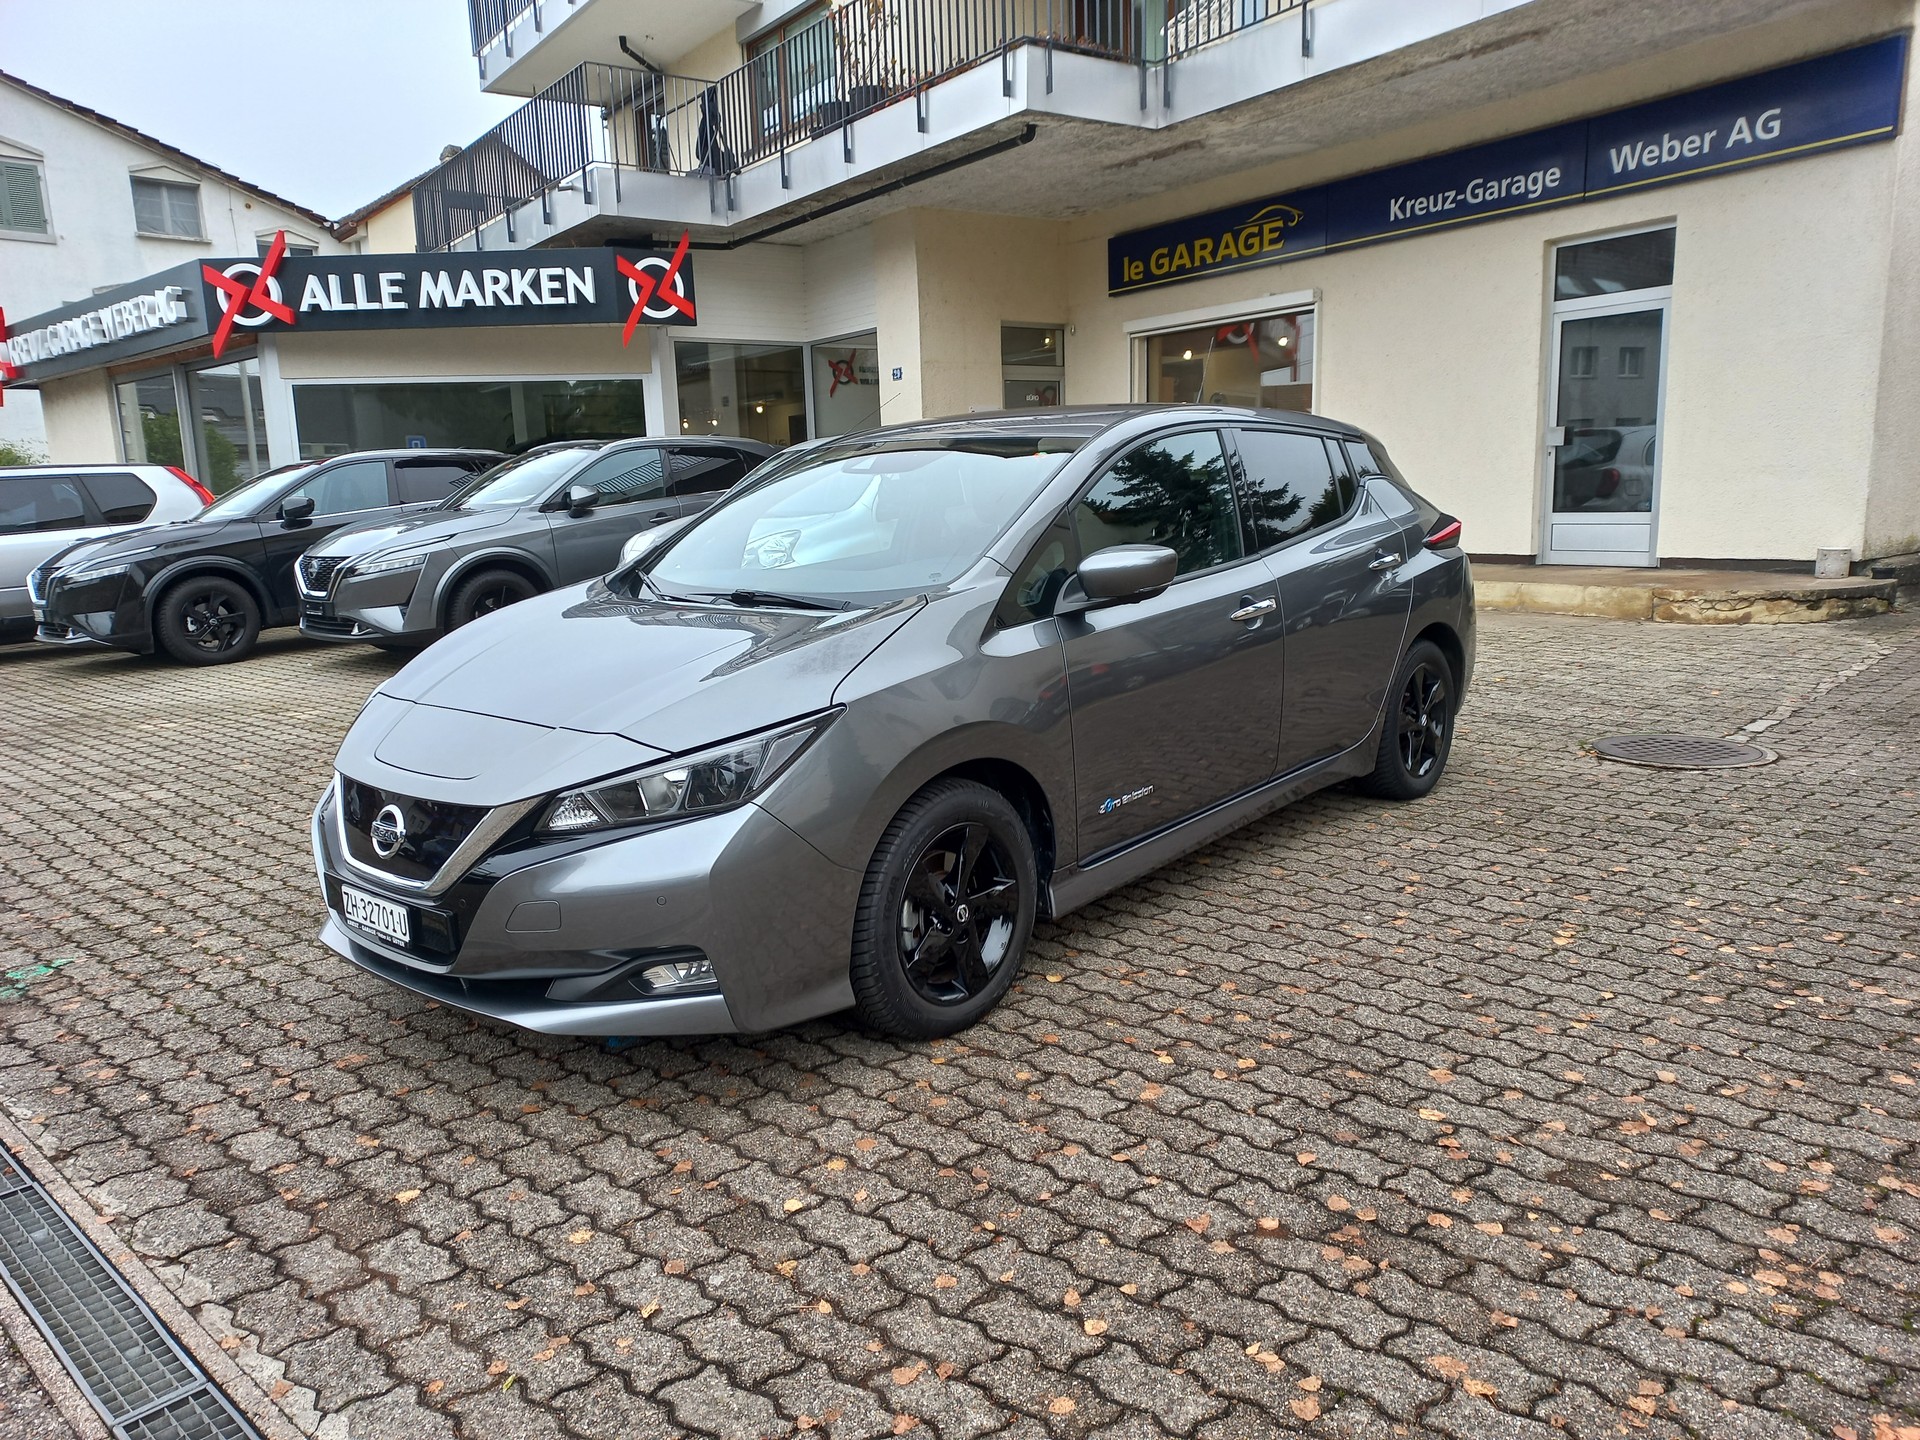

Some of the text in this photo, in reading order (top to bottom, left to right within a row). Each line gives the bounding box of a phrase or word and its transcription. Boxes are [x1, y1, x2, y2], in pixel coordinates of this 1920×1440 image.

[1389, 107, 1783, 222] Kreuz-Garage Weber AG
[1122, 219, 1286, 283] le GARAGE
[299, 265, 597, 312] ALLE MARKEN
[6, 285, 188, 367] KREUZ-GARAGE WEBER AG
